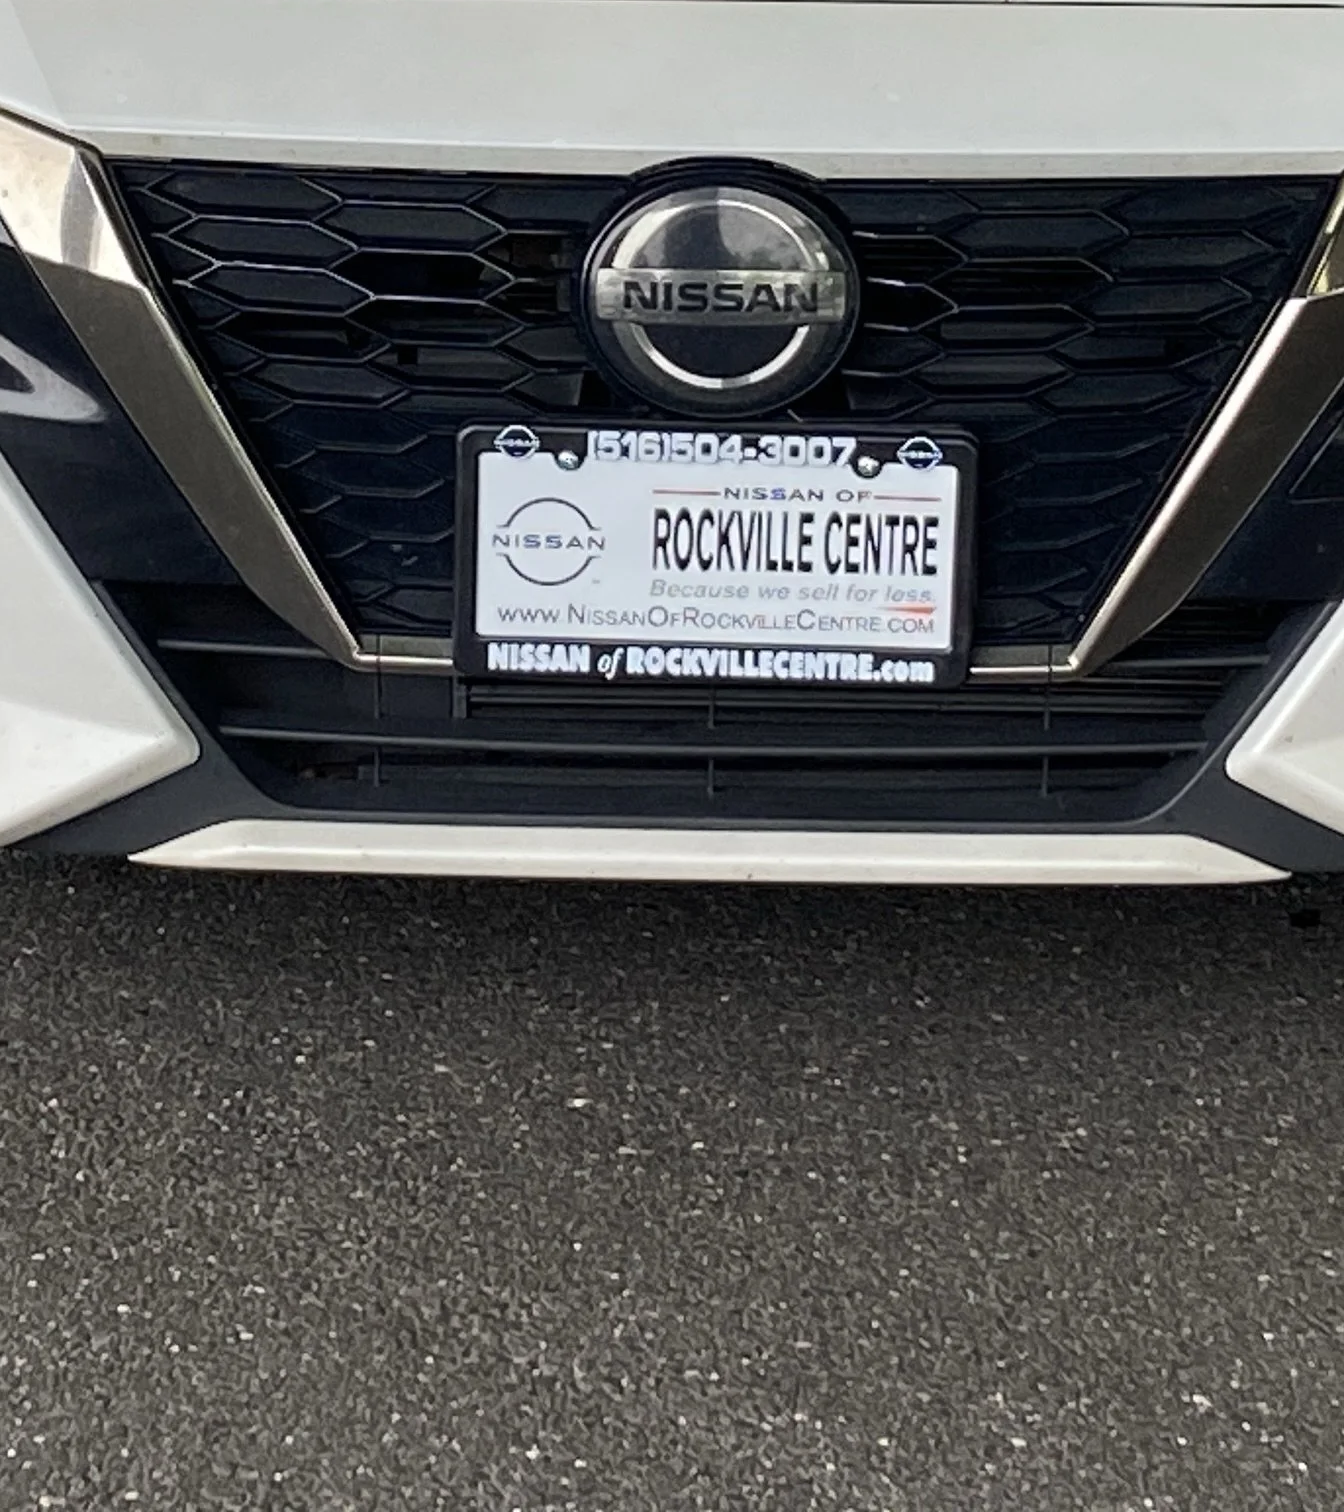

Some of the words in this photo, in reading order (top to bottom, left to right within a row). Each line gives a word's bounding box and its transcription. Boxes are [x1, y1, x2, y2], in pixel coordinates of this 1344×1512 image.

[622, 281, 818, 314] NISSAN
[724, 487, 824, 502] NISSAN
[835, 488, 872, 503] OF
[492, 533, 605, 551] NISSAN
[653, 507, 814, 573] ROCKVILLE
[824, 509, 939, 576] CENTRE
[649, 578, 750, 599] Because
[758, 584, 790, 601] we
[798, 582, 839, 602] sell
[846, 582, 878, 603] for
[487, 641, 590, 672] NISSAN
[597, 646, 624, 681] of
[626, 645, 935, 683] ROCKVILLECENTRE.com
